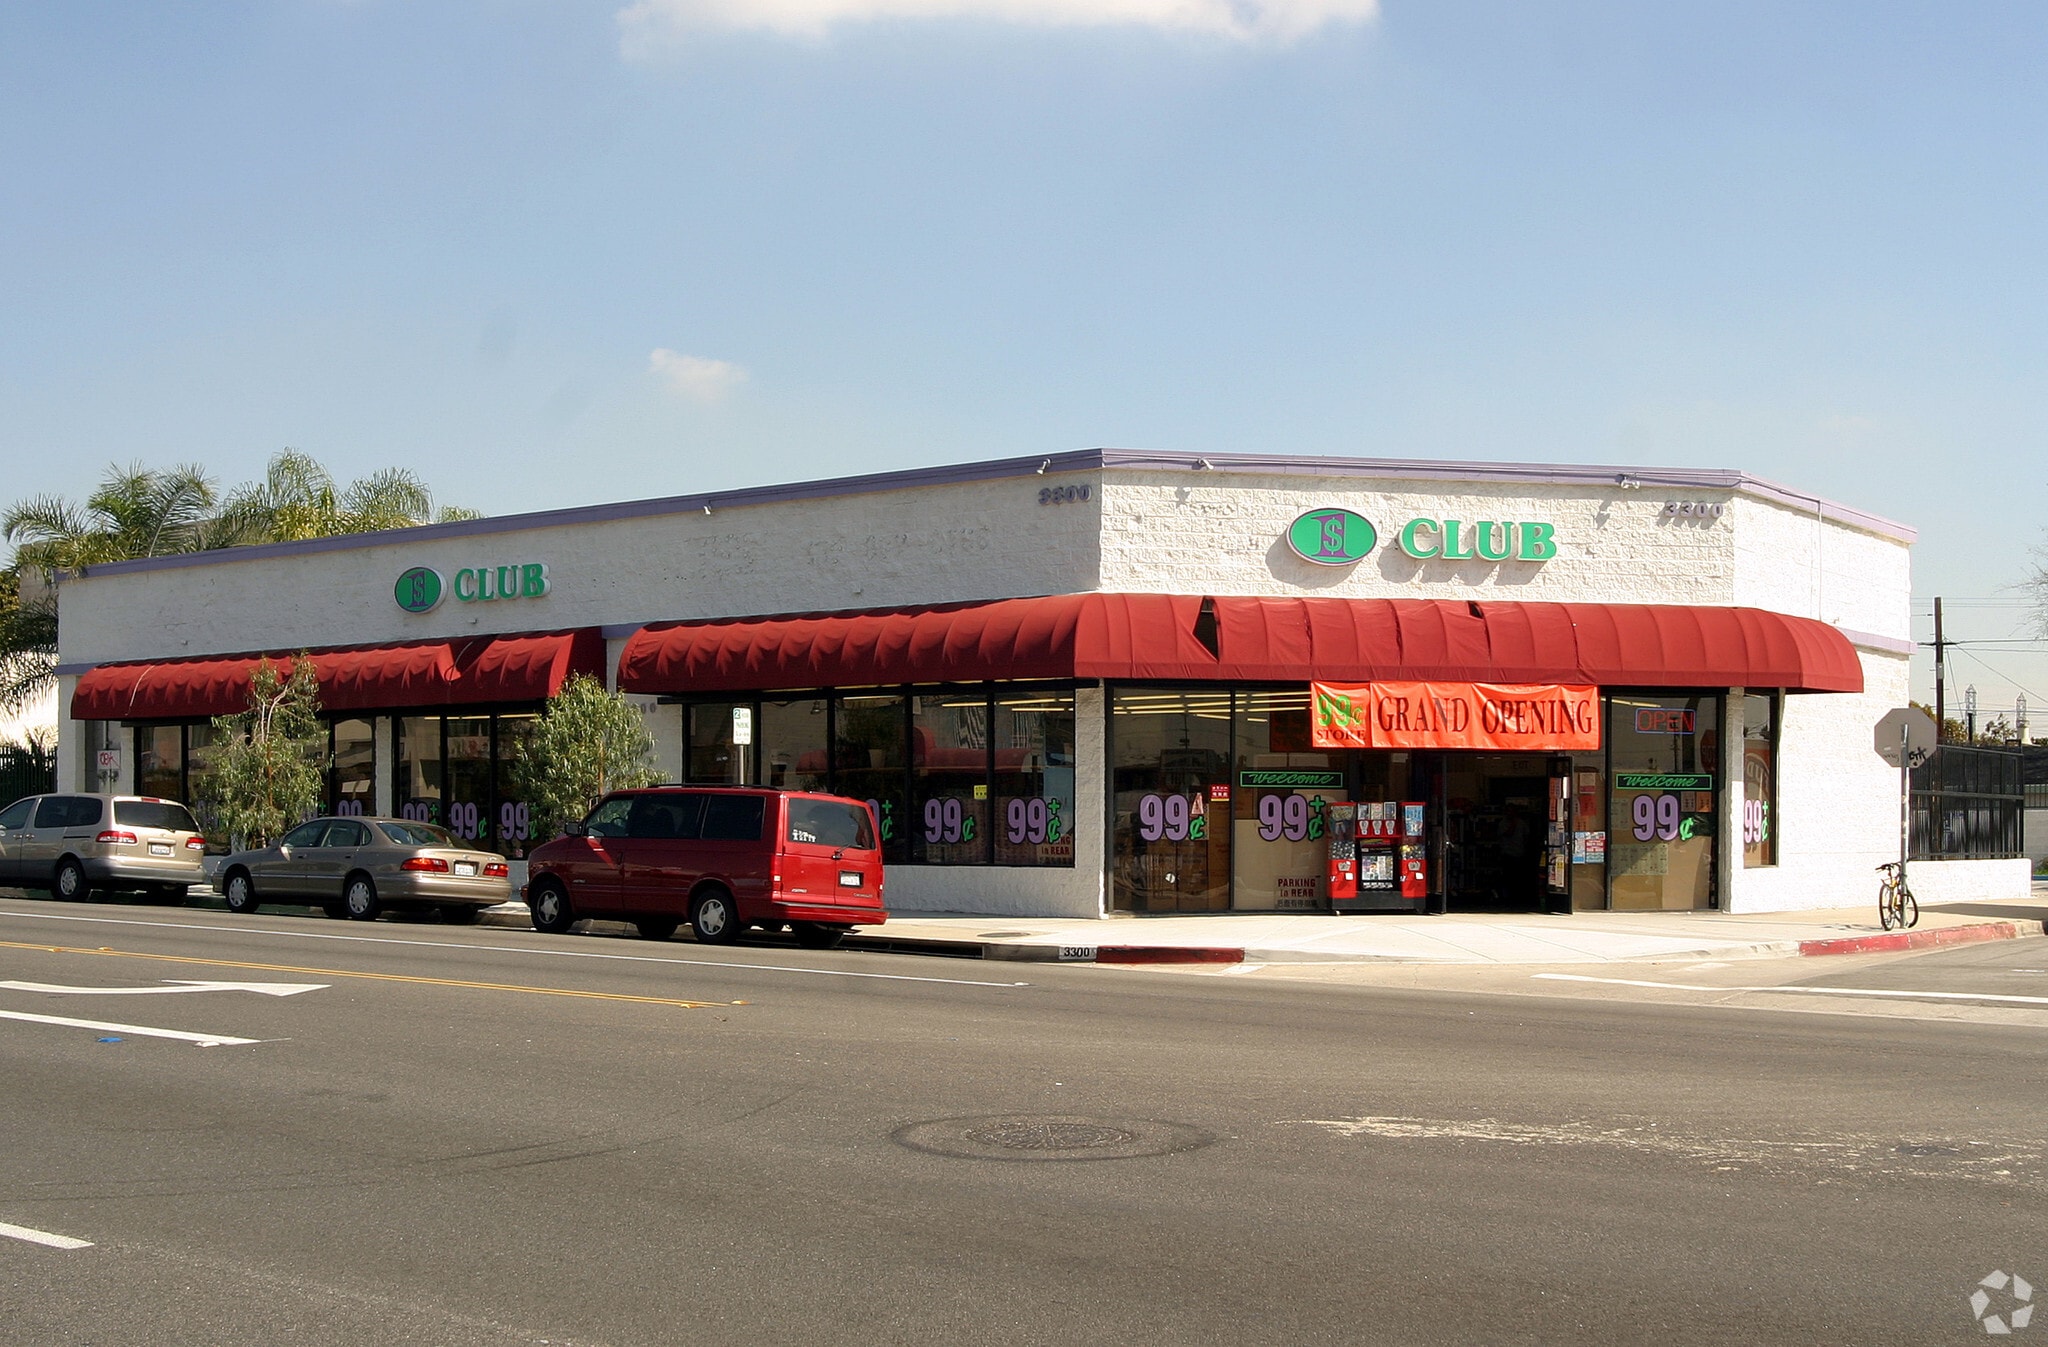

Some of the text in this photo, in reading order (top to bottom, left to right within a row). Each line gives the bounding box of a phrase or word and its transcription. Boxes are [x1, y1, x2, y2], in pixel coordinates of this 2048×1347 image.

[1663, 500, 1724, 518] 3300
[1400, 517, 1558, 562] CLUB
[454, 562, 549, 602] CLUB
[1377, 696, 1593, 735] GRAND OPENING
[1638, 709, 1694, 732] OPEN
[1050, 846, 1071, 855] REAR
[1277, 878, 1316, 888] PARKING
[1291, 888, 1314, 897] REAR
[1064, 947, 1090, 957] 3300
